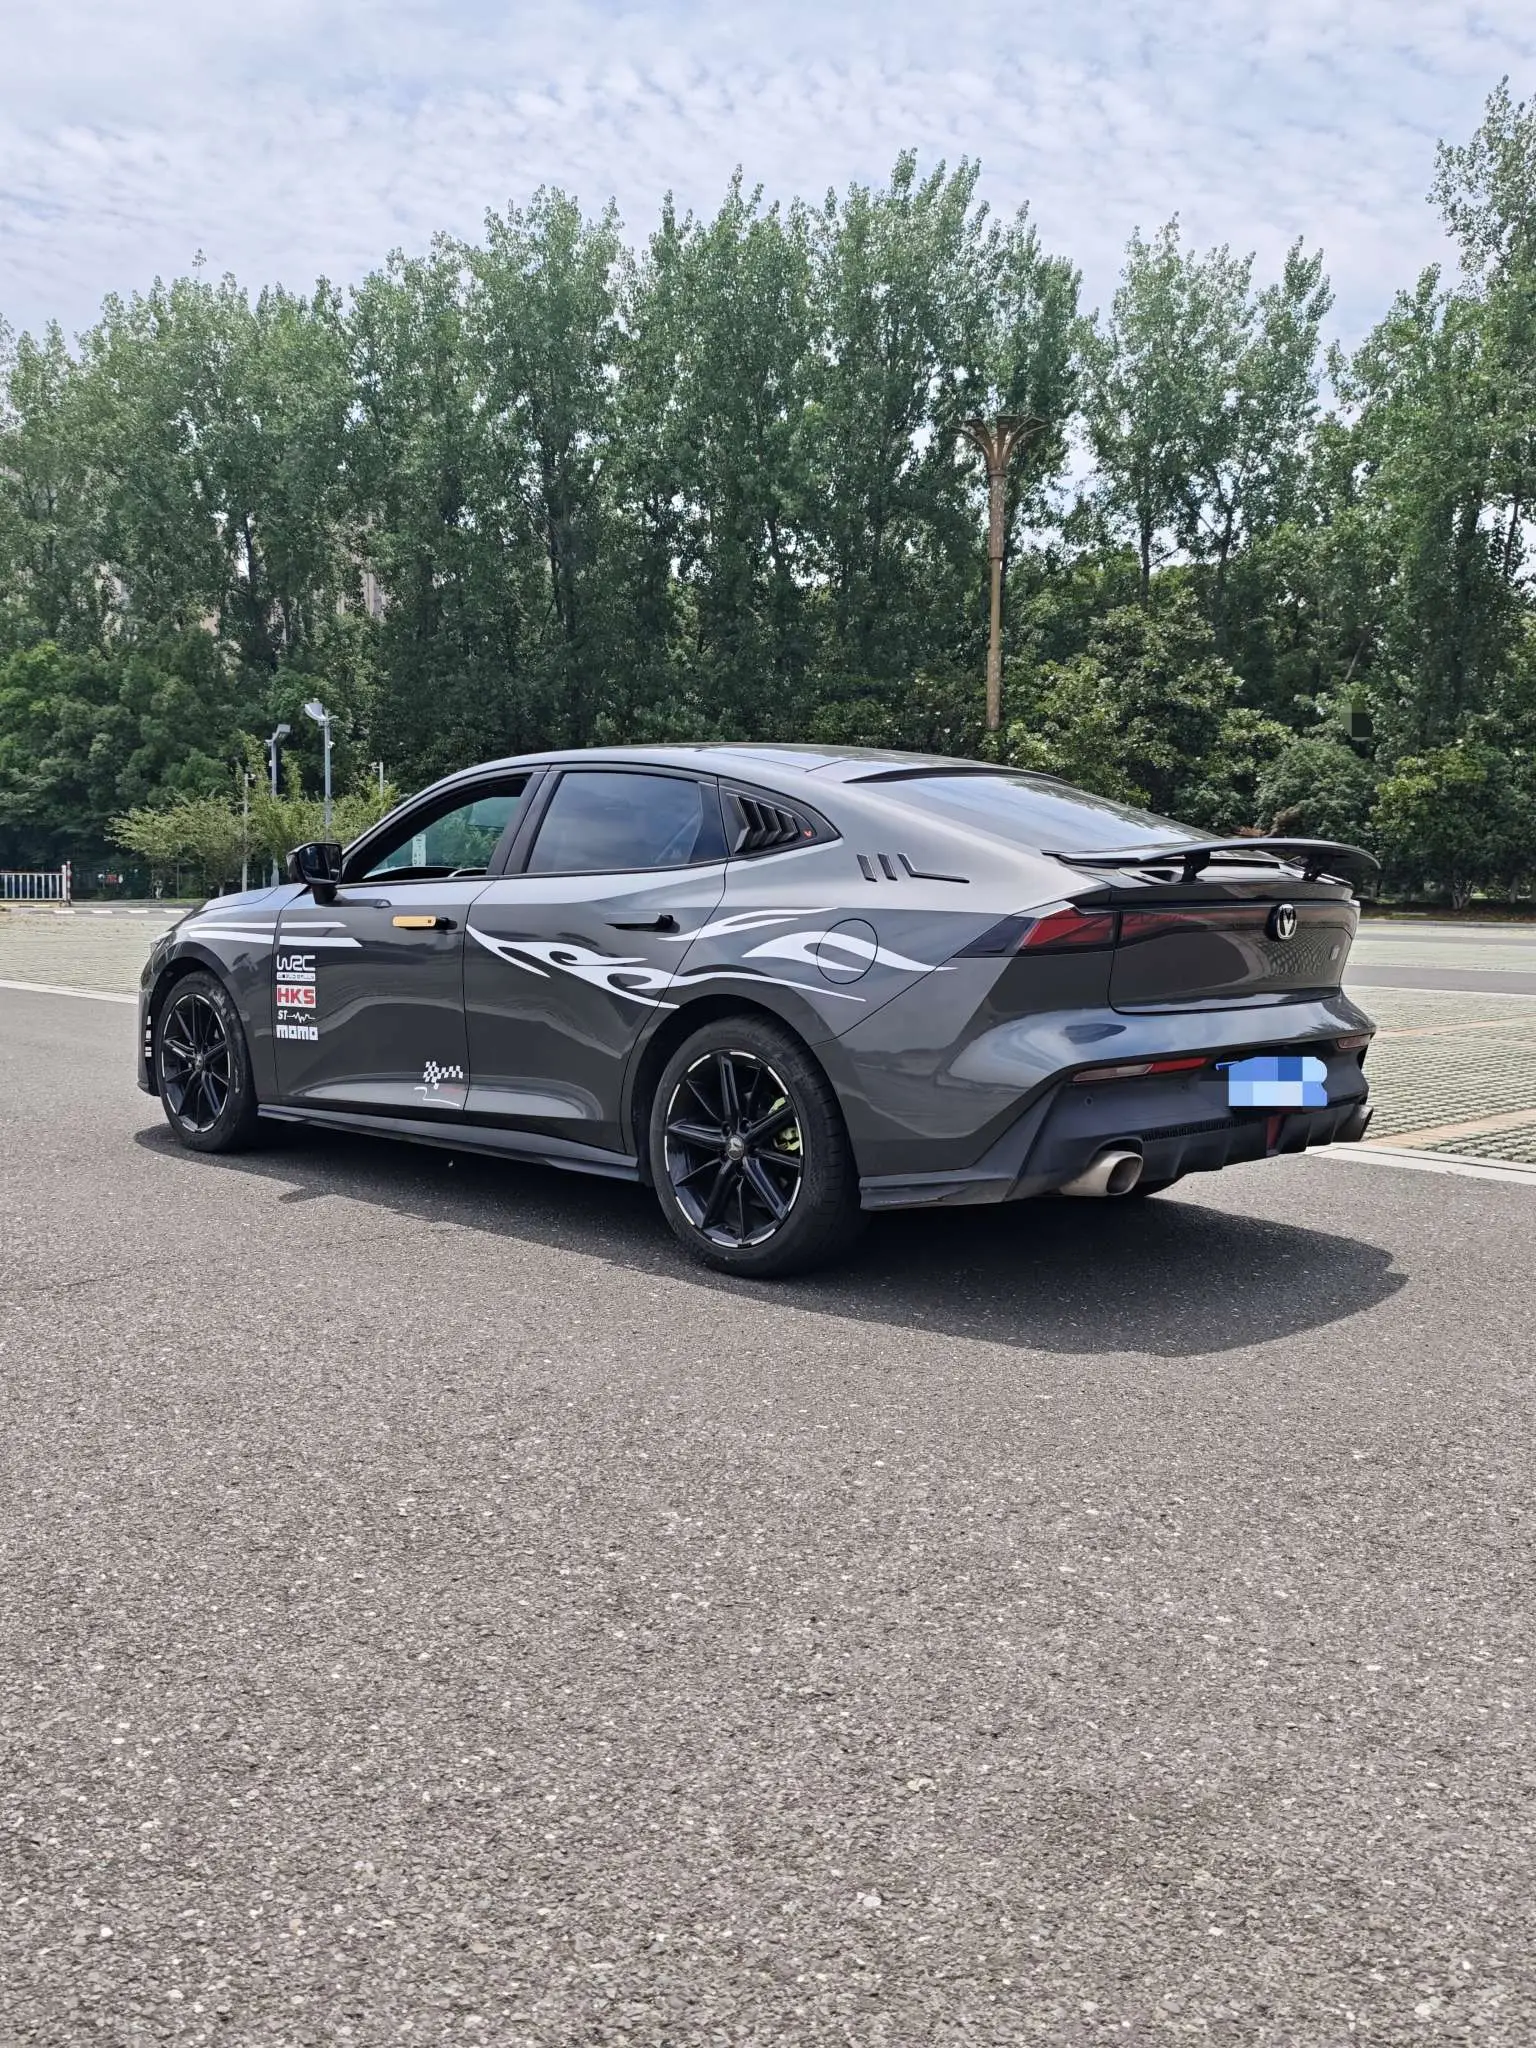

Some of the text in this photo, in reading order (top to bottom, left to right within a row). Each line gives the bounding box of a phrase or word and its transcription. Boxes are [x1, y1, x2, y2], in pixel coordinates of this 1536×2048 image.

[277, 954, 316, 971] WRC
[277, 987, 316, 1005] HKS
[277, 1010, 288, 1021] ST
